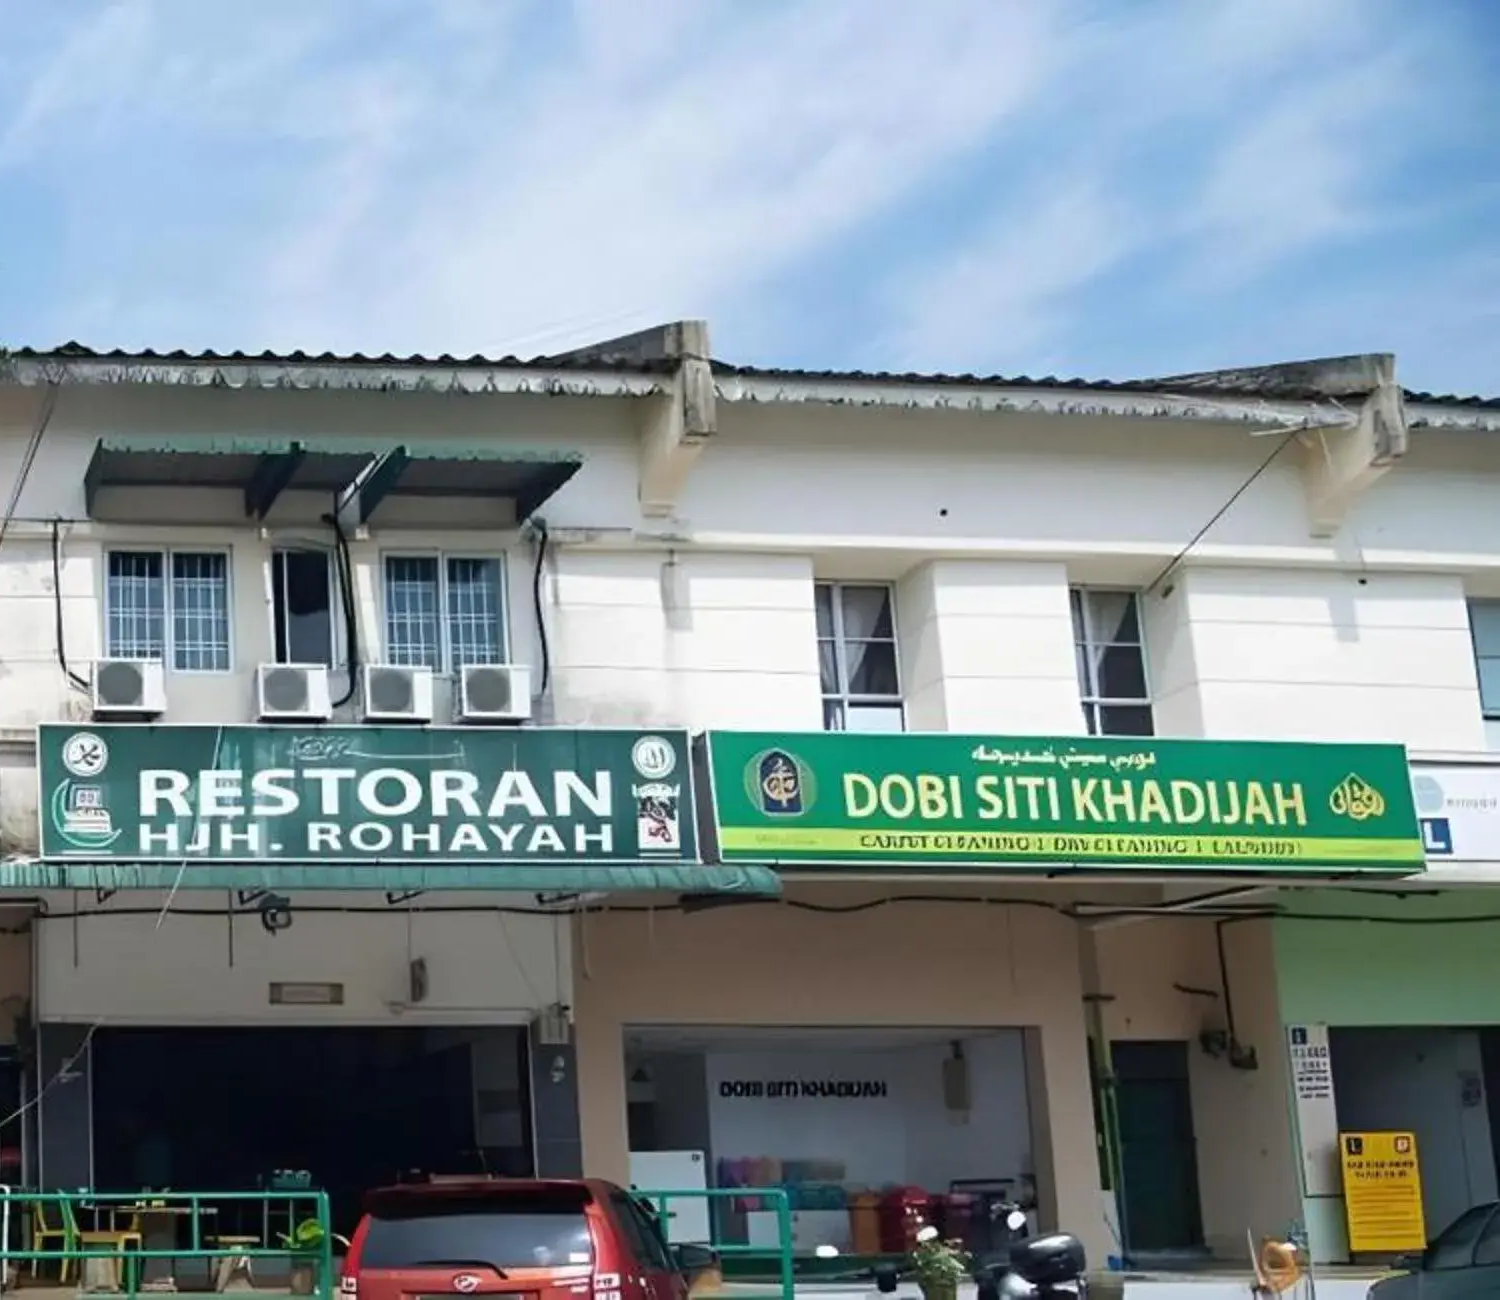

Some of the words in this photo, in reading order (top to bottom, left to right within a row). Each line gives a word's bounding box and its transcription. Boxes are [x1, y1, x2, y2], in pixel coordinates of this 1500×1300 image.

[139, 767, 613, 817] RESTORAN
[842, 772, 963, 819] DOBI
[975, 774, 1060, 821] SITI
[1071, 777, 1307, 826] KHADIJAH
[139, 823, 283, 851] HJH.
[308, 822, 613, 852] ROHAYAH
[1423, 821, 1446, 849] L
